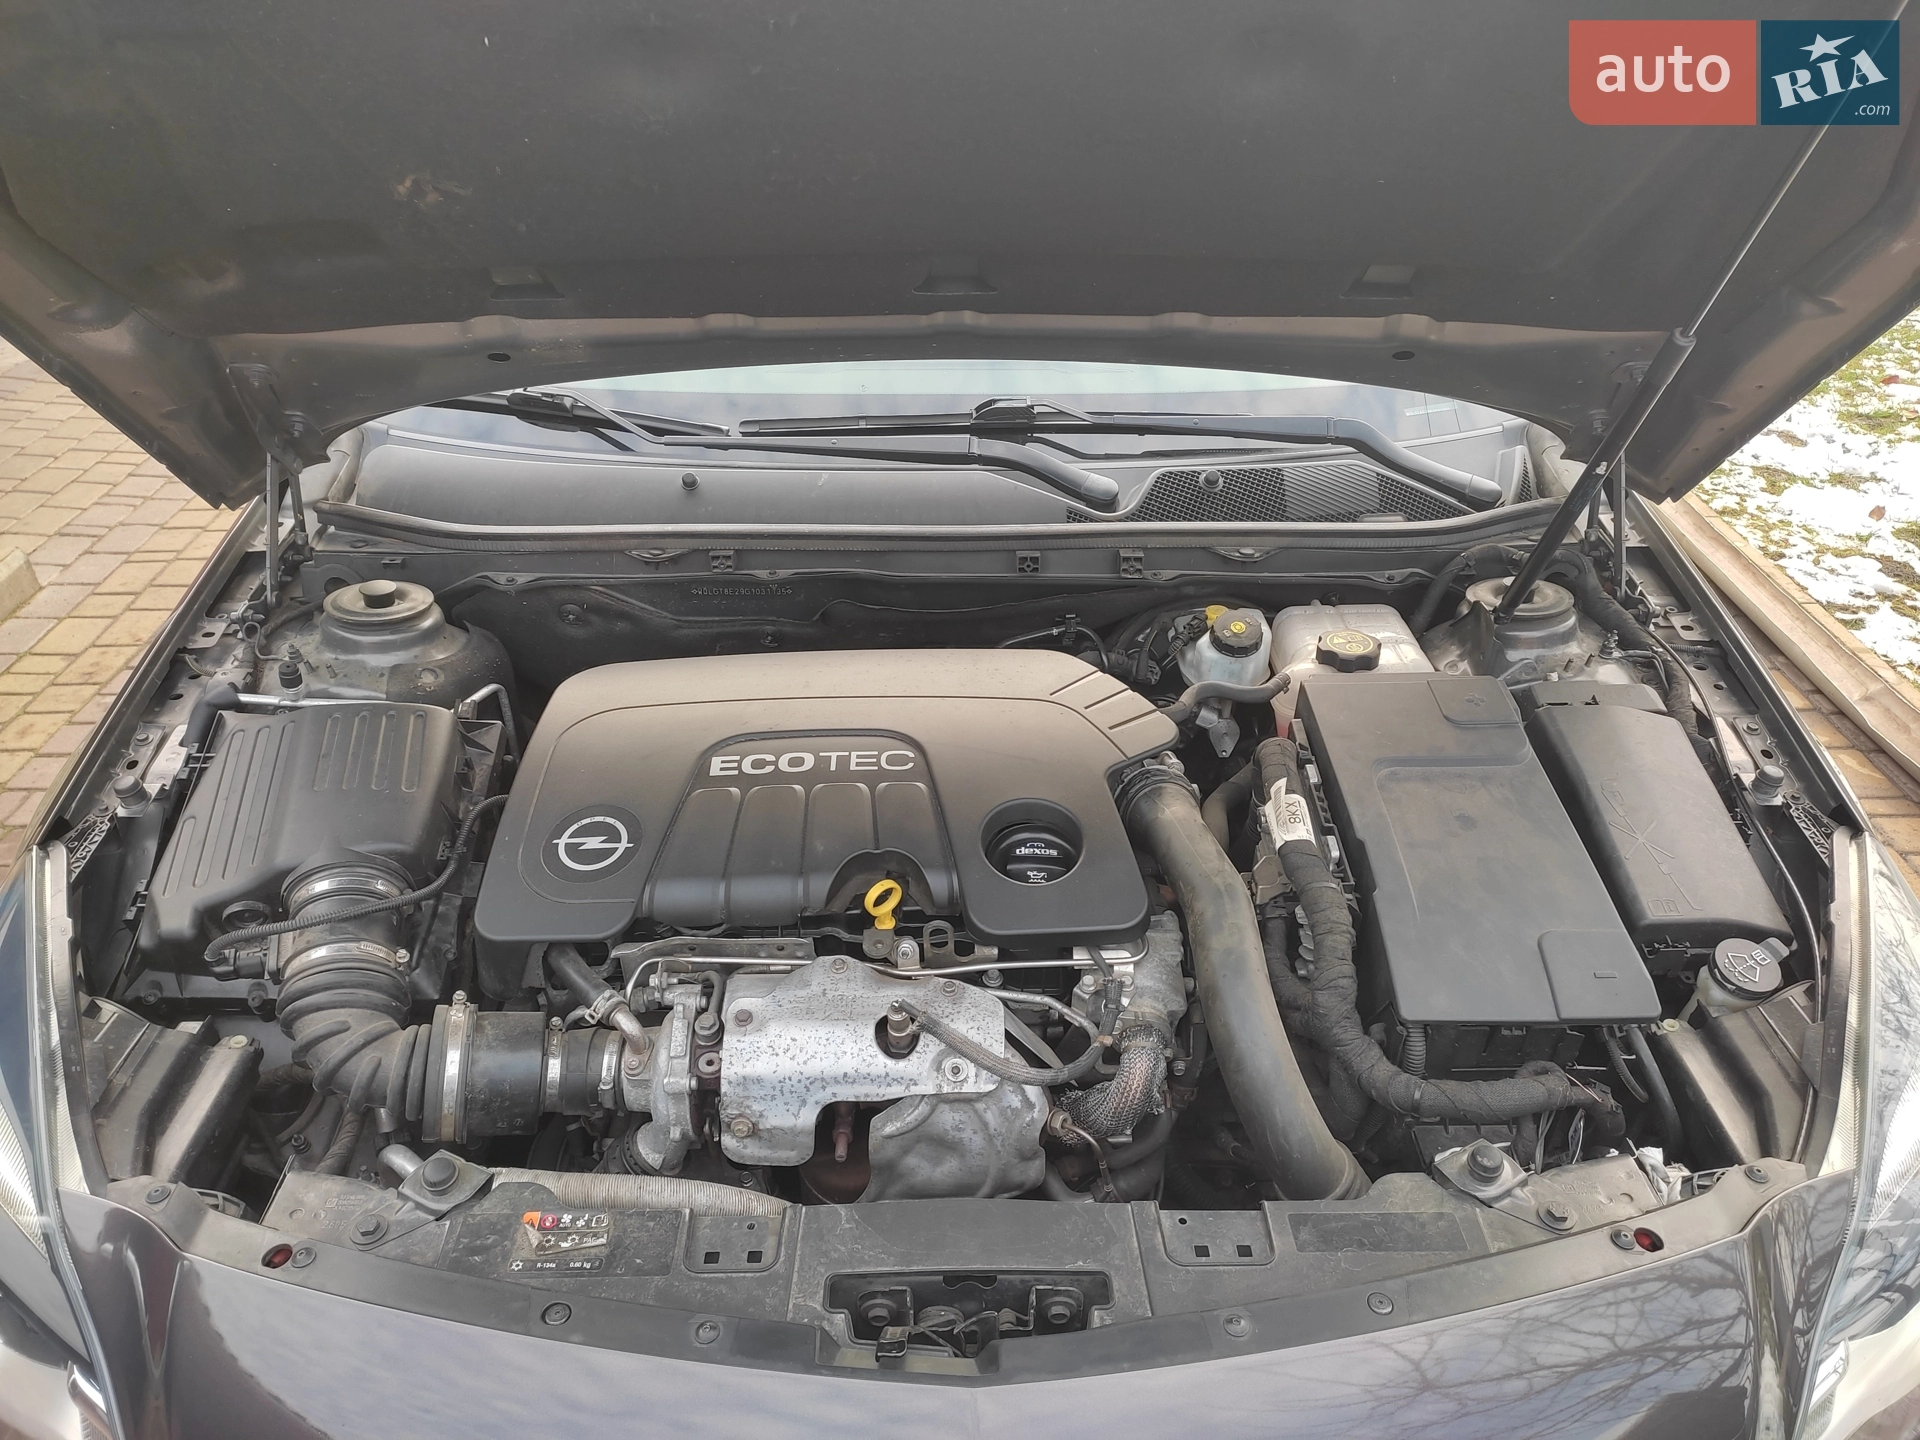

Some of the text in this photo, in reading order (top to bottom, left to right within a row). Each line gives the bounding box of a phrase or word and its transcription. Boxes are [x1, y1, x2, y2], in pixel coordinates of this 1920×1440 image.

[708, 750, 916, 777] ECOTEC
[1285, 801, 1302, 824] 8KX
[1015, 846, 1058, 856] dexos
[583, 1261, 592, 1270] kg
